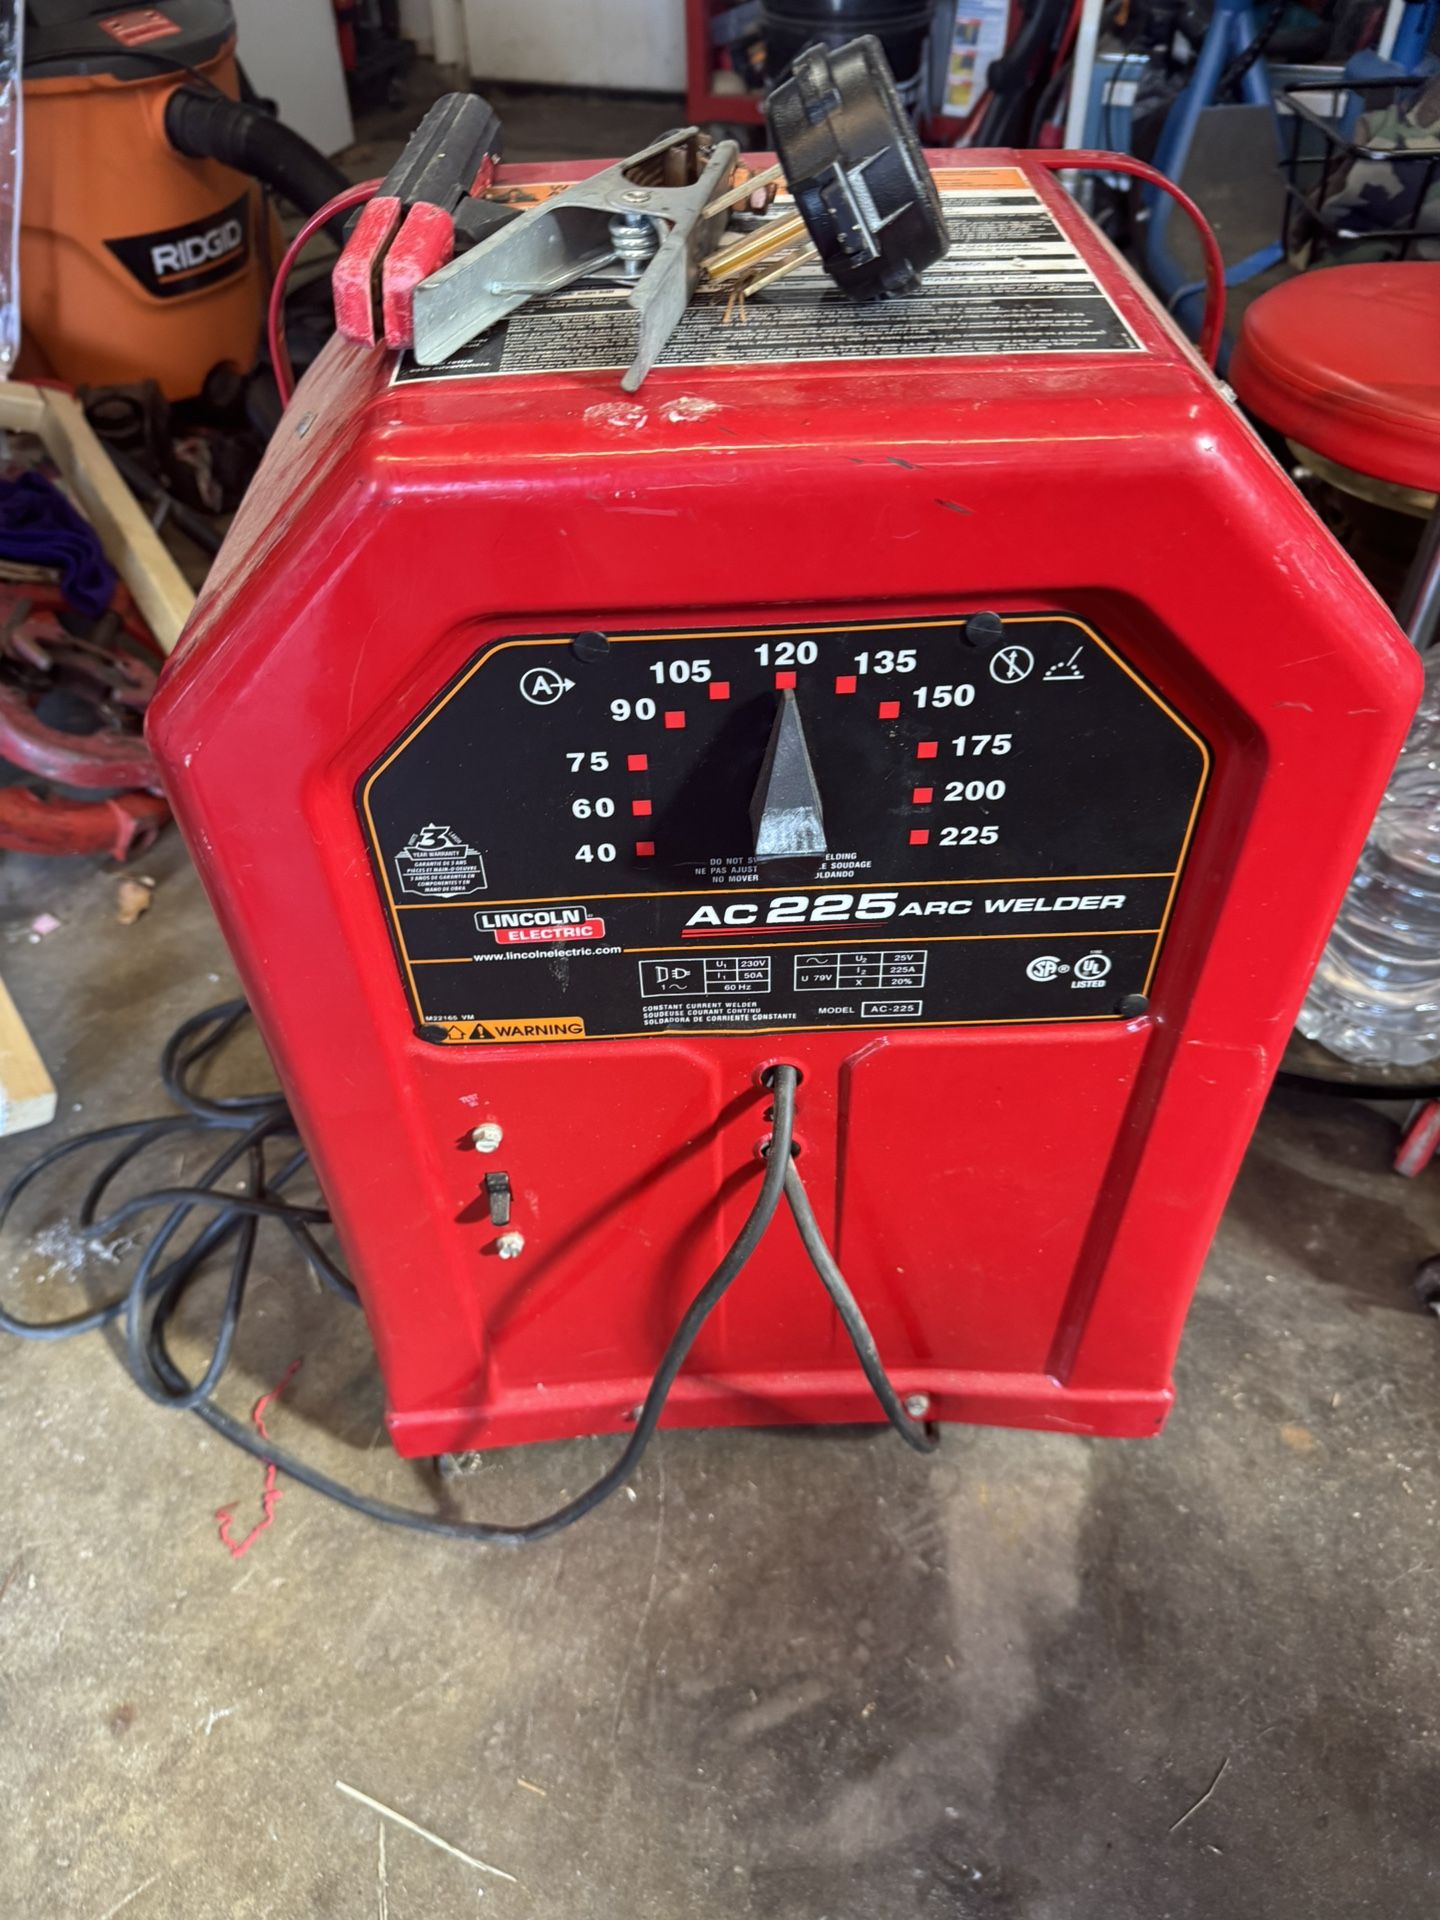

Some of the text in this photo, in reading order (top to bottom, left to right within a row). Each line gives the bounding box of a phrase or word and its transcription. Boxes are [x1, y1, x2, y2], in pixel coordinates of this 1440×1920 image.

[151, 220, 243, 276] RIDGID
[754, 641, 818, 666] 120
[854, 649, 917, 675] 135
[650, 660, 712, 684] 105
[913, 684, 975, 708] 150
[610, 698, 656, 721] 90
[951, 734, 1012, 756] 175
[566, 752, 609, 772] 75
[944, 780, 1006, 801] 200
[572, 797, 615, 818] 60
[939, 826, 999, 846] 225
[575, 843, 616, 862] 40
[710, 858, 722, 866] DO
[726, 857, 743, 866] NOT
[825, 852, 857, 861] ELDING
[712, 870, 854, 883] NO MOVER LDANDO
[731, 866, 758, 874] AJUST
[831, 861, 872, 870] SOUDAGE
[481, 909, 580, 929] LINCOLN
[685, 893, 1127, 926] AC 225 ARC WELDER
[508, 926, 593, 941] ELECTRIC
[474, 946, 622, 962] www.lincolnelectric.com
[741, 960, 766, 968] 230V
[738, 983, 752, 991] Hz
[1071, 980, 1106, 989] LISTED
[642, 1003, 683, 1012] CONSTANT
[643, 1010, 684, 1018] SOUDEUSE
[688, 1008, 723, 1016] COURANT
[818, 1005, 915, 1014] MODEL AC-225
[644, 1017, 691, 1026] SOLDADORA
[752, 1012, 797, 1021] CONSTANTE
[495, 1023, 583, 1037] WARNING
